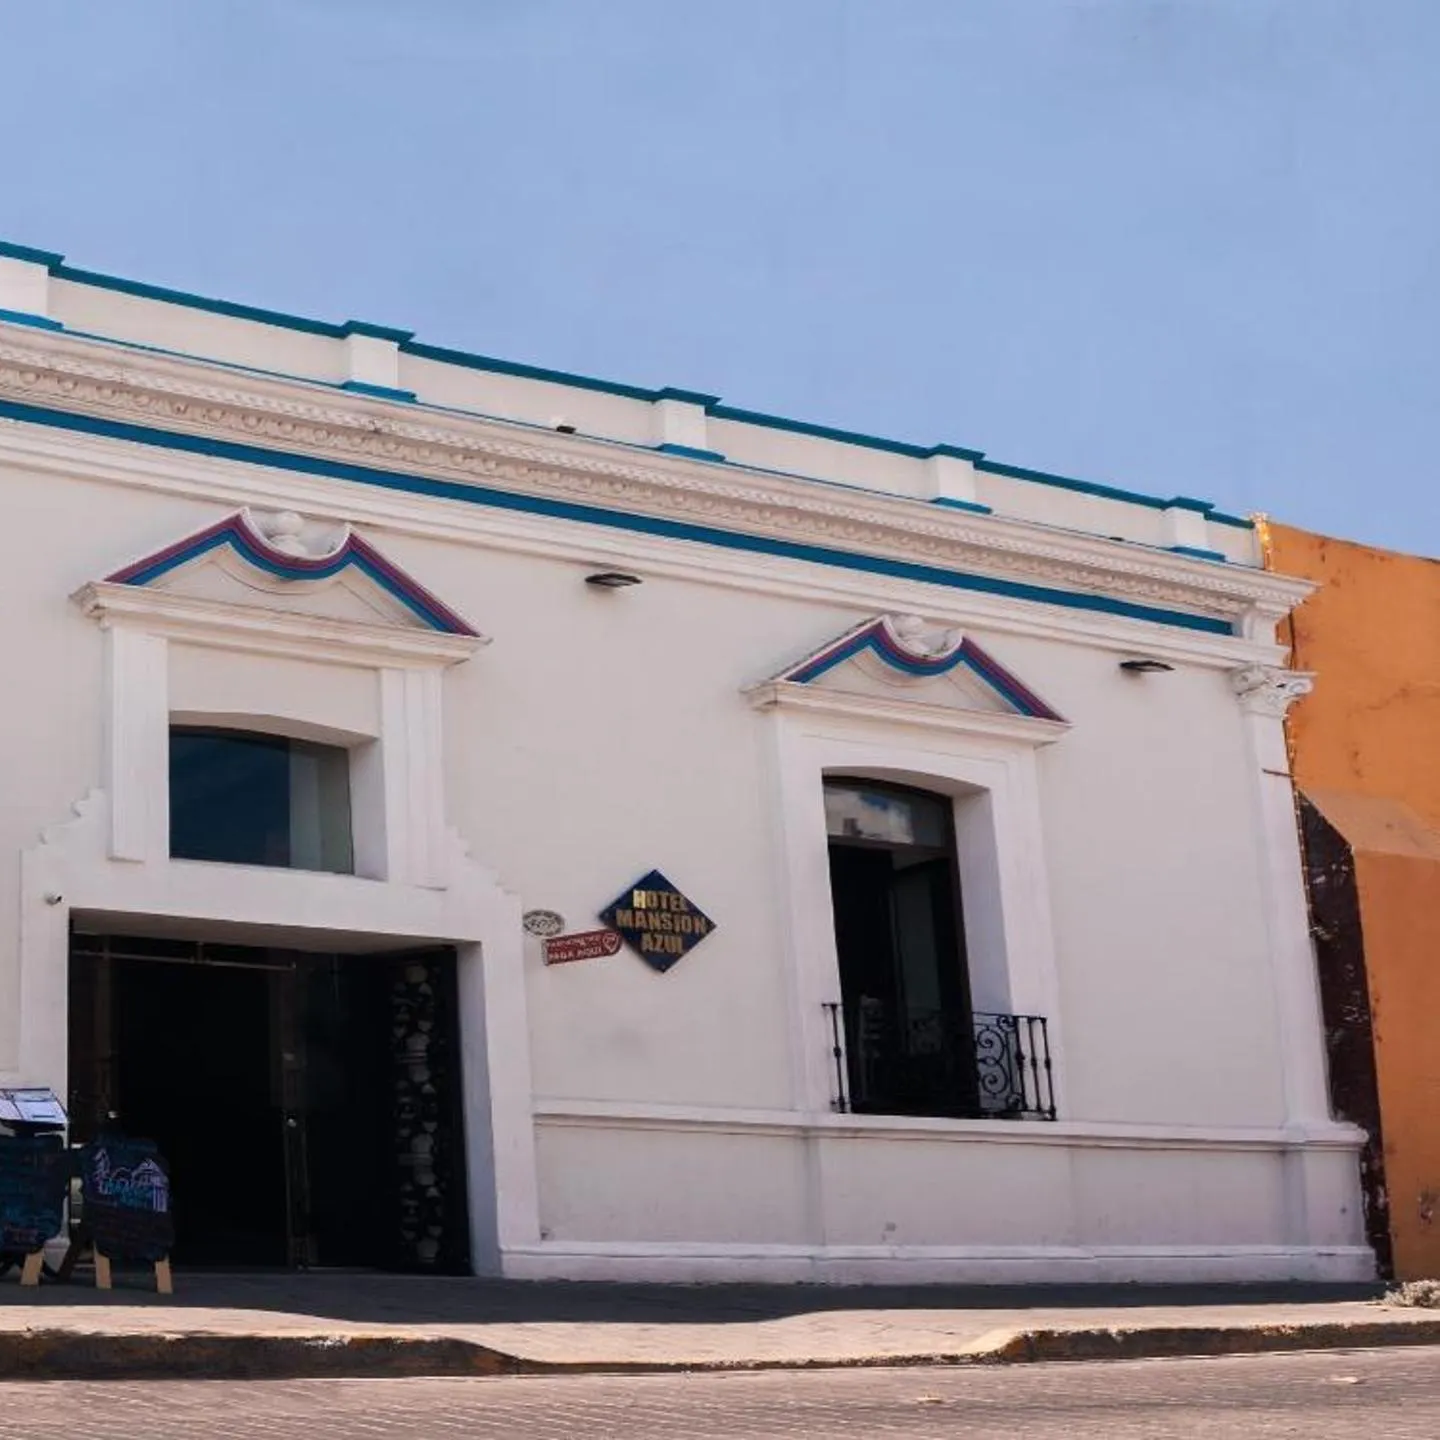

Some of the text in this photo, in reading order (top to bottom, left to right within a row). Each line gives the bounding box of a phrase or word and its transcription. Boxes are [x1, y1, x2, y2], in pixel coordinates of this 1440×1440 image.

[632, 889, 688, 912] HOTEL
[615, 908, 707, 934] MANSION
[640, 931, 683, 954] AZUL
